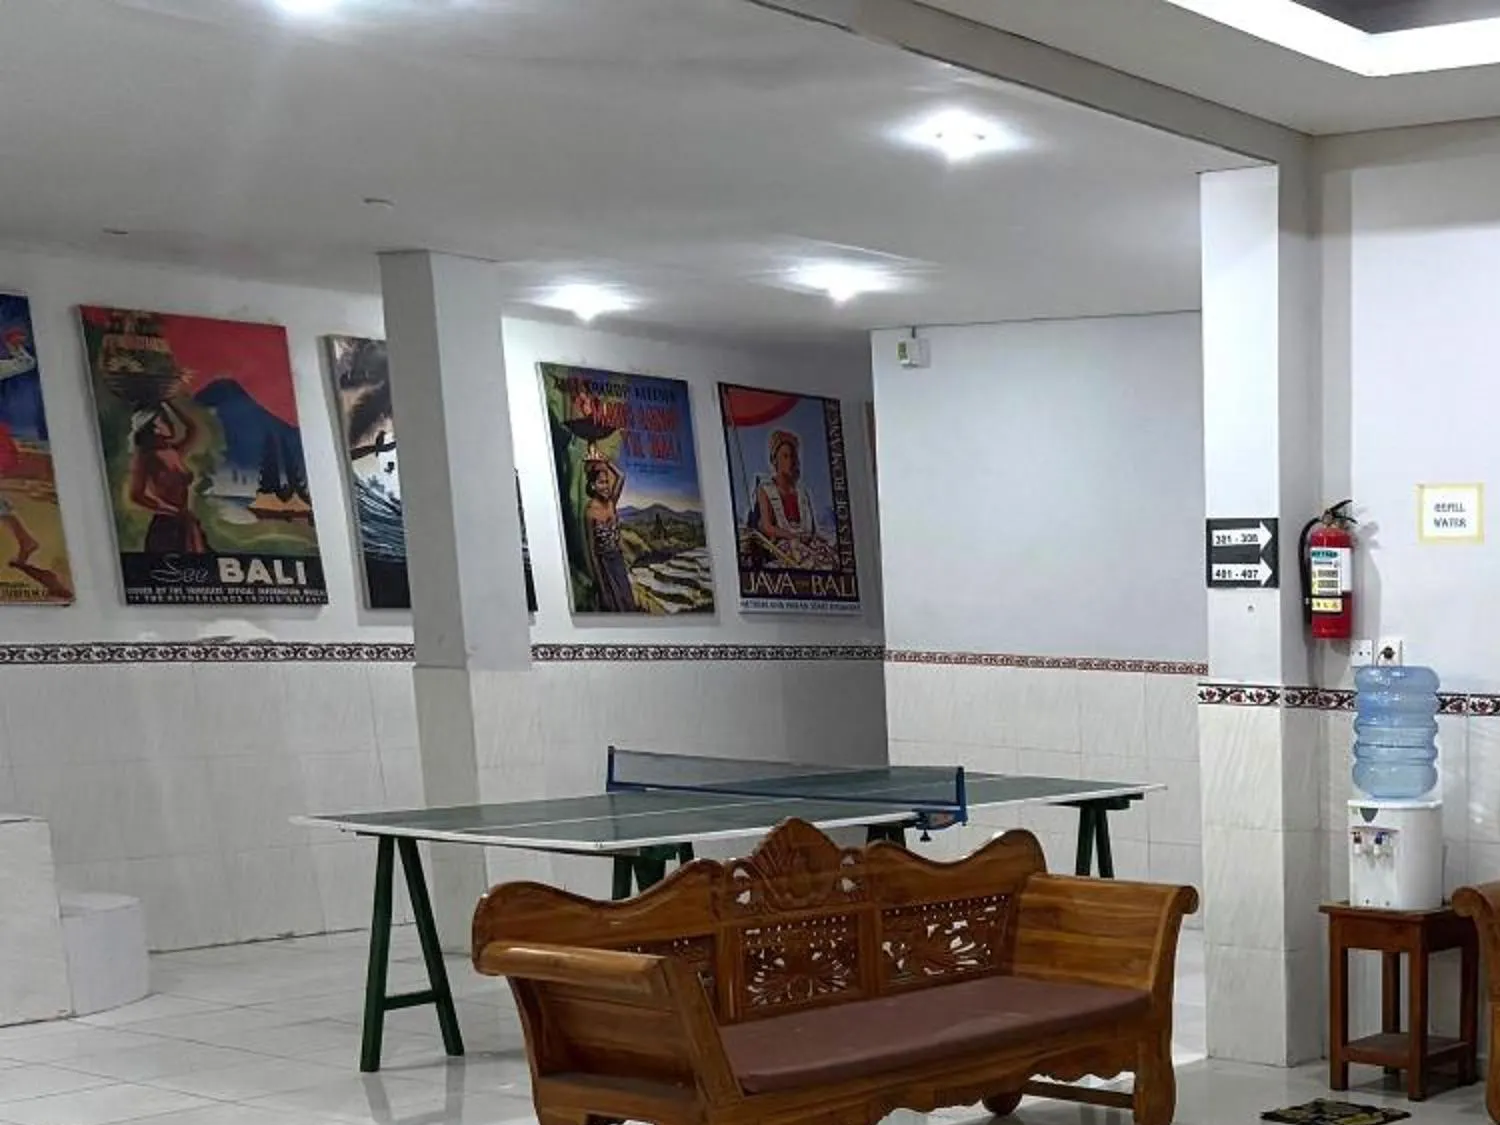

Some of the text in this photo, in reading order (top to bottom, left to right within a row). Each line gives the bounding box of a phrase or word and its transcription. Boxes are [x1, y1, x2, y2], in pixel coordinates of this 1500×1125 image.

[1433, 517, 1467, 528] WATER
[151, 553, 307, 585] See BALI
[743, 571, 797, 595] JAVA
[811, 574, 857, 598] BALI
